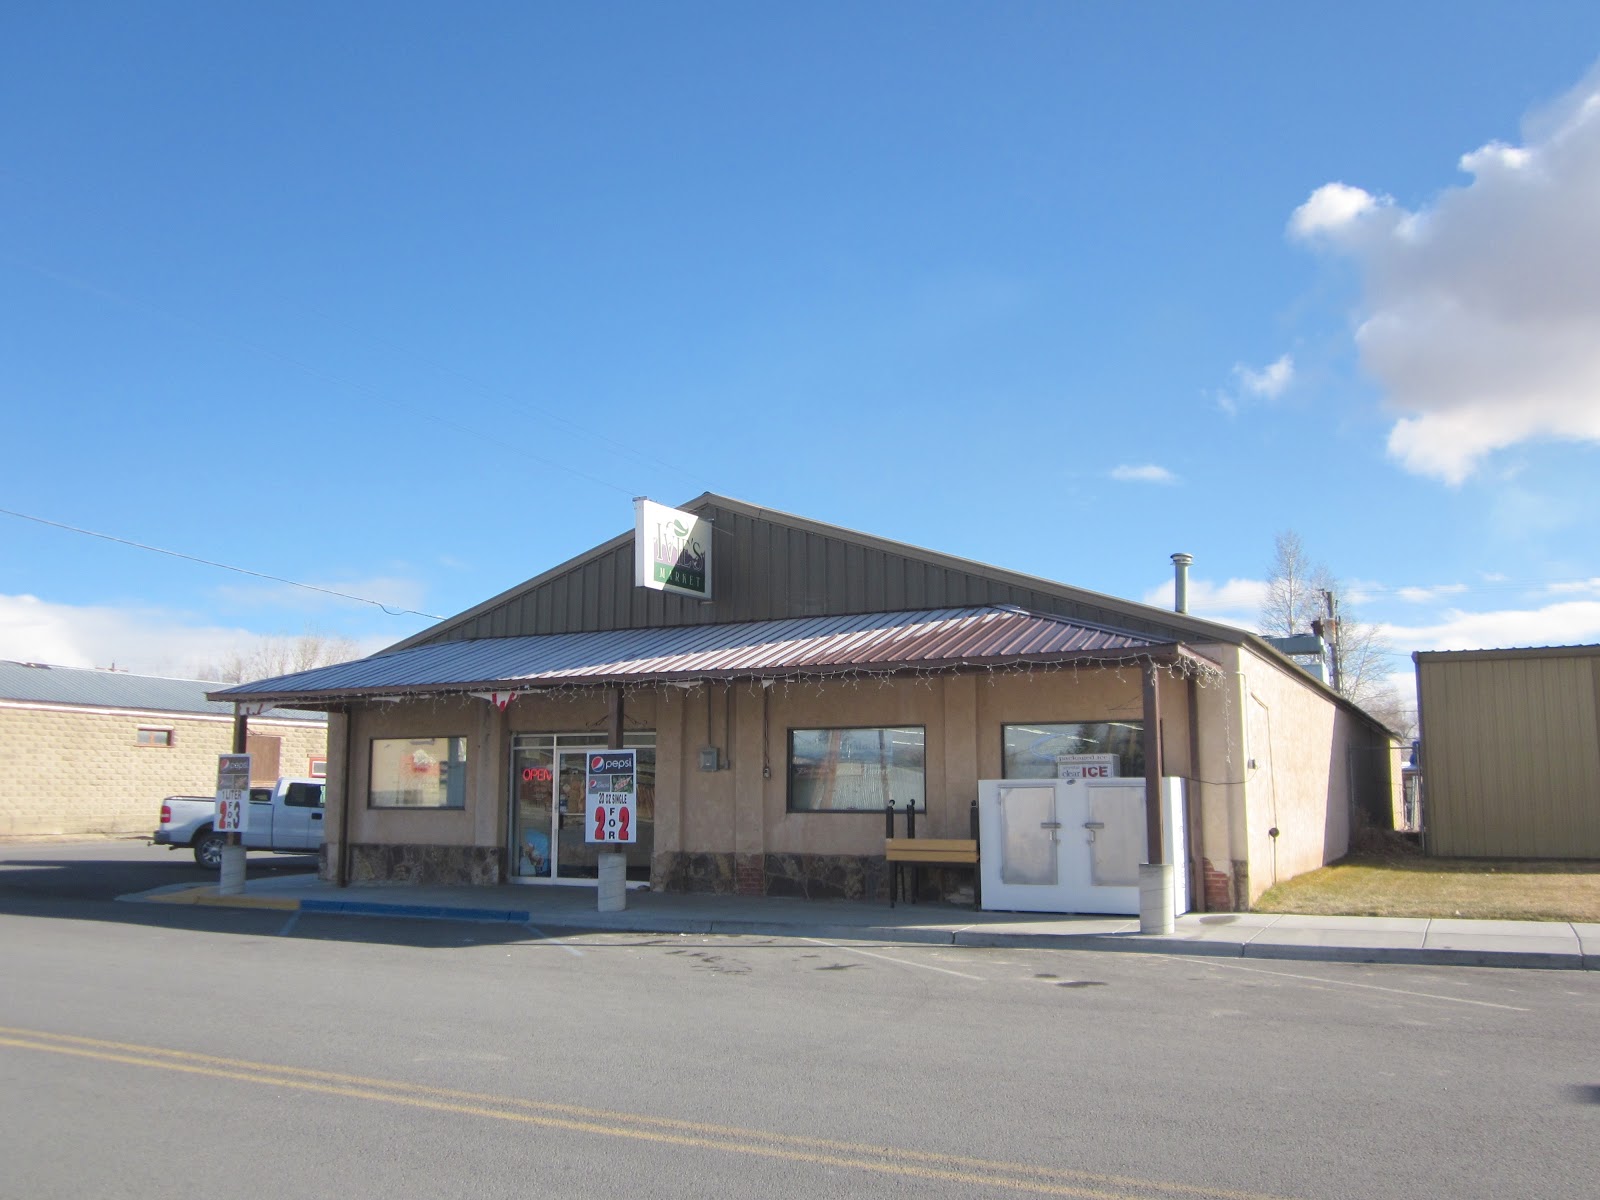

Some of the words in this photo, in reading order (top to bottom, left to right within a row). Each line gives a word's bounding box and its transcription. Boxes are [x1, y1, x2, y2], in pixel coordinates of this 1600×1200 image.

[659, 567, 701, 587] MARKET
[605, 757, 632, 770] pepsi
[1059, 754, 1095, 762] packaged
[522, 768, 553, 781] OPEN
[1062, 770, 1080, 778] clear
[1081, 766, 1109, 778] ICE
[226, 789, 242, 800] LITER
[599, 793, 605, 805] 20
[612, 794, 627, 804] SINGLE
[219, 801, 227, 829] 2
[233, 801, 241, 829] 3
[595, 806, 606, 840] 2
[618, 806, 630, 840] 2
